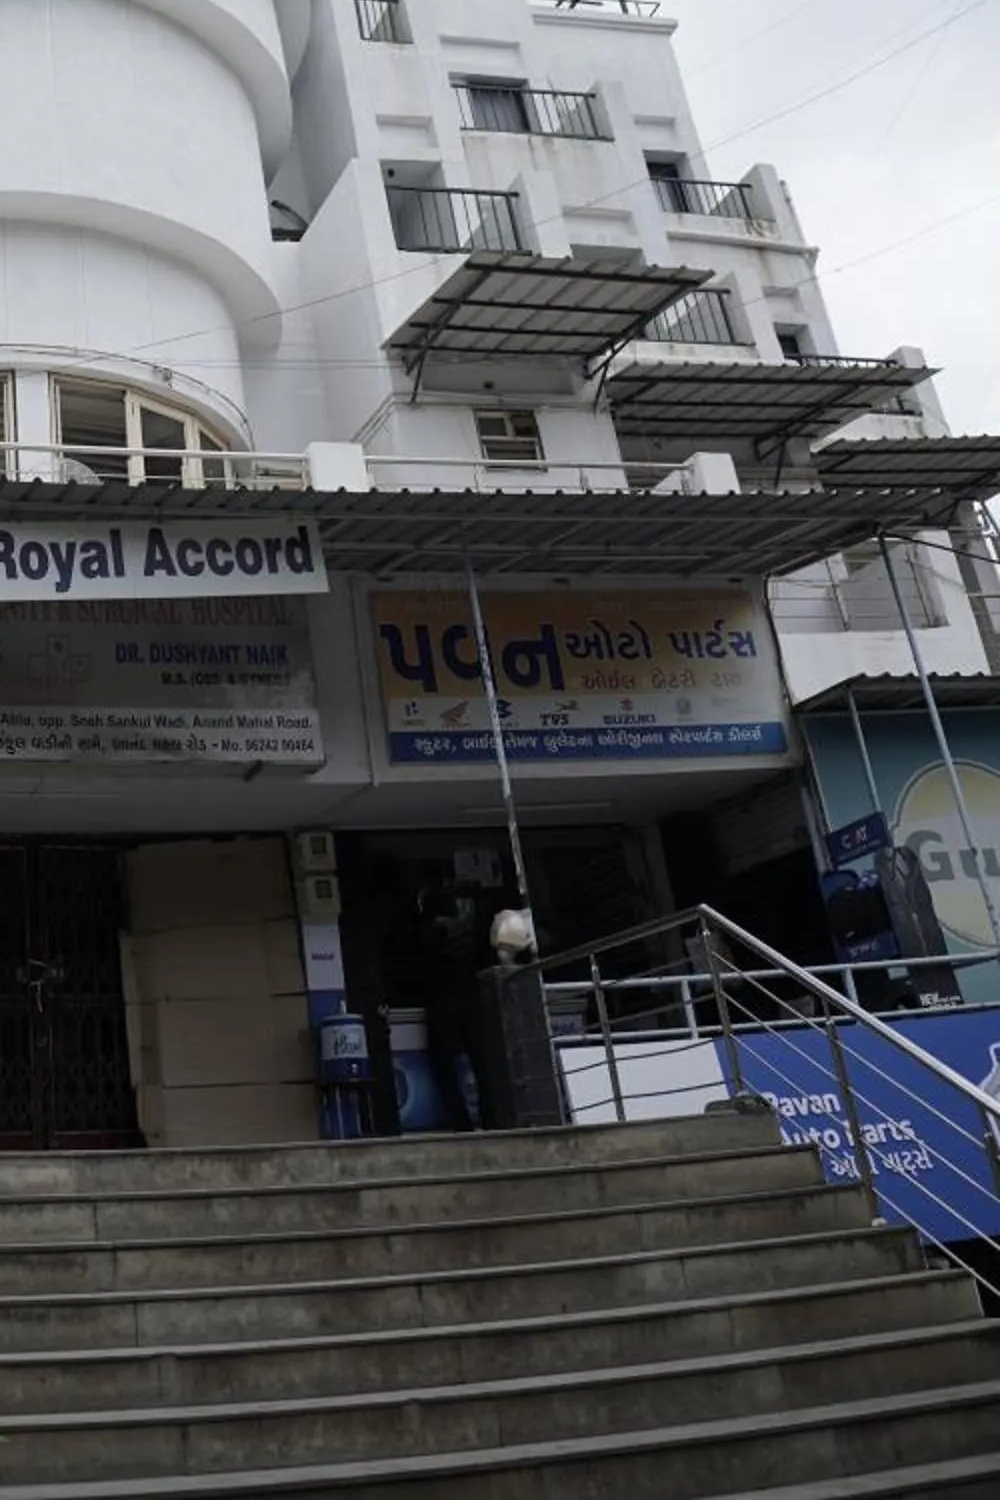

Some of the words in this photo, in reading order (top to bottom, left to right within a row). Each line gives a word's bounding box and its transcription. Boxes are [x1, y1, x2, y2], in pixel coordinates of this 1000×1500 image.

[144, 525, 314, 577] Accord
[114, 642, 146, 664] DR.
[150, 643, 241, 665] DUSHYANT
[245, 644, 289, 666] NAIK
[379, 621, 565, 695] પવન
[565, 618, 653, 661] ઓટો
[277, 717, 313, 731] Road.
[539, 713, 570, 726] TVS
[602, 713, 657, 726] SUZUKI
